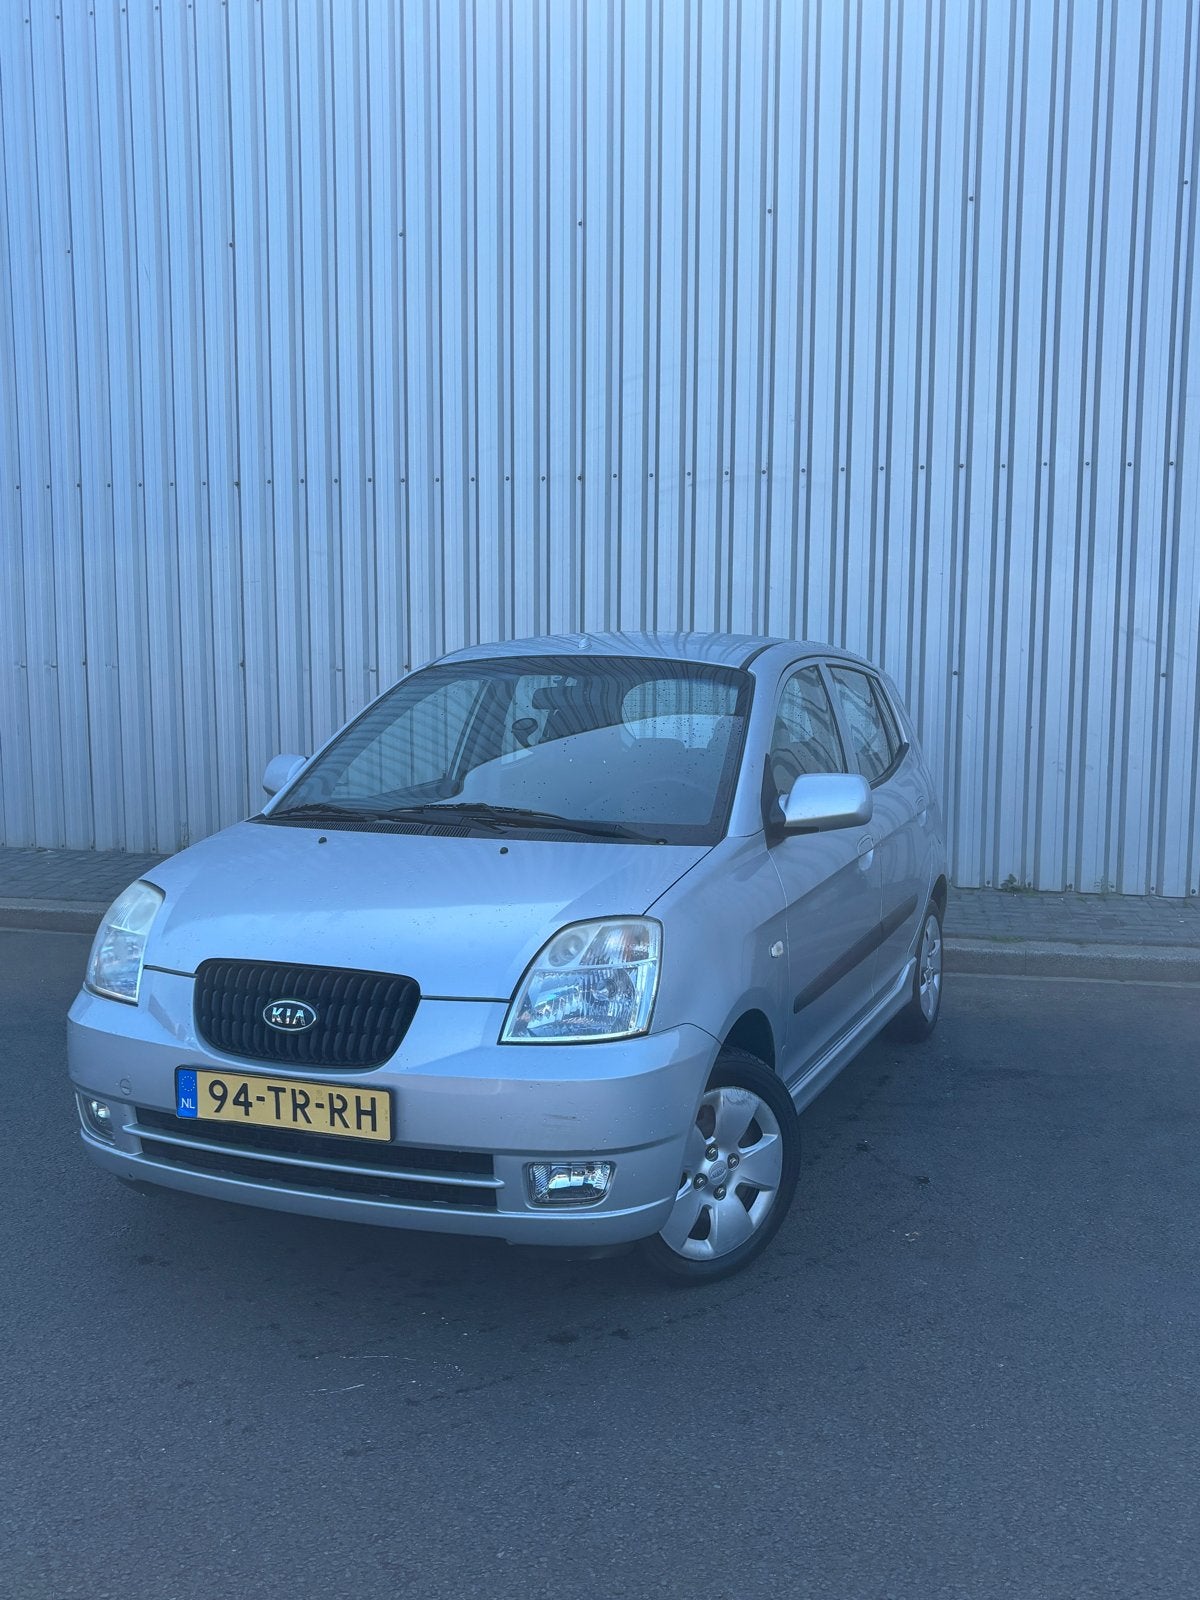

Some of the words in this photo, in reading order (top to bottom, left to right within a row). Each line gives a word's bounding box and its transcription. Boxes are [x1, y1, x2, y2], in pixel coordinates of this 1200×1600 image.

[271, 1007, 306, 1026] KIA
[181, 1097, 196, 1109] NL
[208, 1079, 377, 1132] 94-TR-RH
